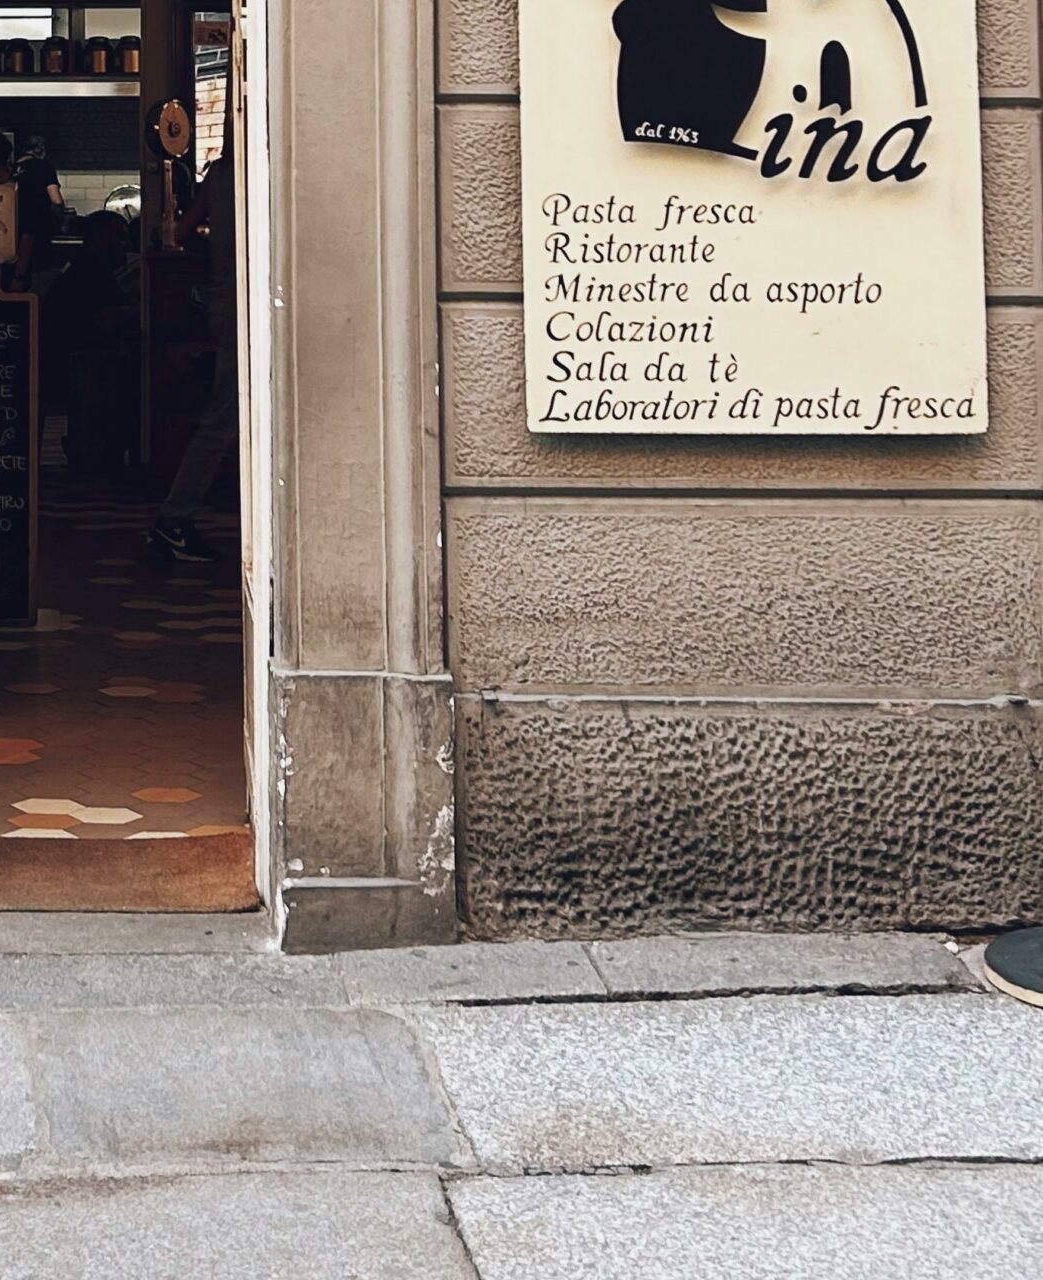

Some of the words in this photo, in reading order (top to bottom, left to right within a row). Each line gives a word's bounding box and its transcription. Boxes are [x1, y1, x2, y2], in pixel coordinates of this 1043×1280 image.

[634, 121, 666, 139] dal
[669, 126, 700, 144] 1963
[541, 193, 637, 227] Pasta
[655, 195, 757, 232] fresca
[544, 231, 716, 264] Ristorante
[544, 273, 690, 304] Minestre
[709, 272, 751, 304] da
[766, 272, 883, 314] asporto
[545, 310, 714, 344] Colazioni
[546, 351, 628, 383] Sala
[643, 351, 687, 383] da
[708, 352, 739, 384] tè
[538, 388, 720, 423] Laboratori
[728, 387, 764, 420] di
[772, 395, 862, 428] pasta
[863, 385, 976, 431] fresca
